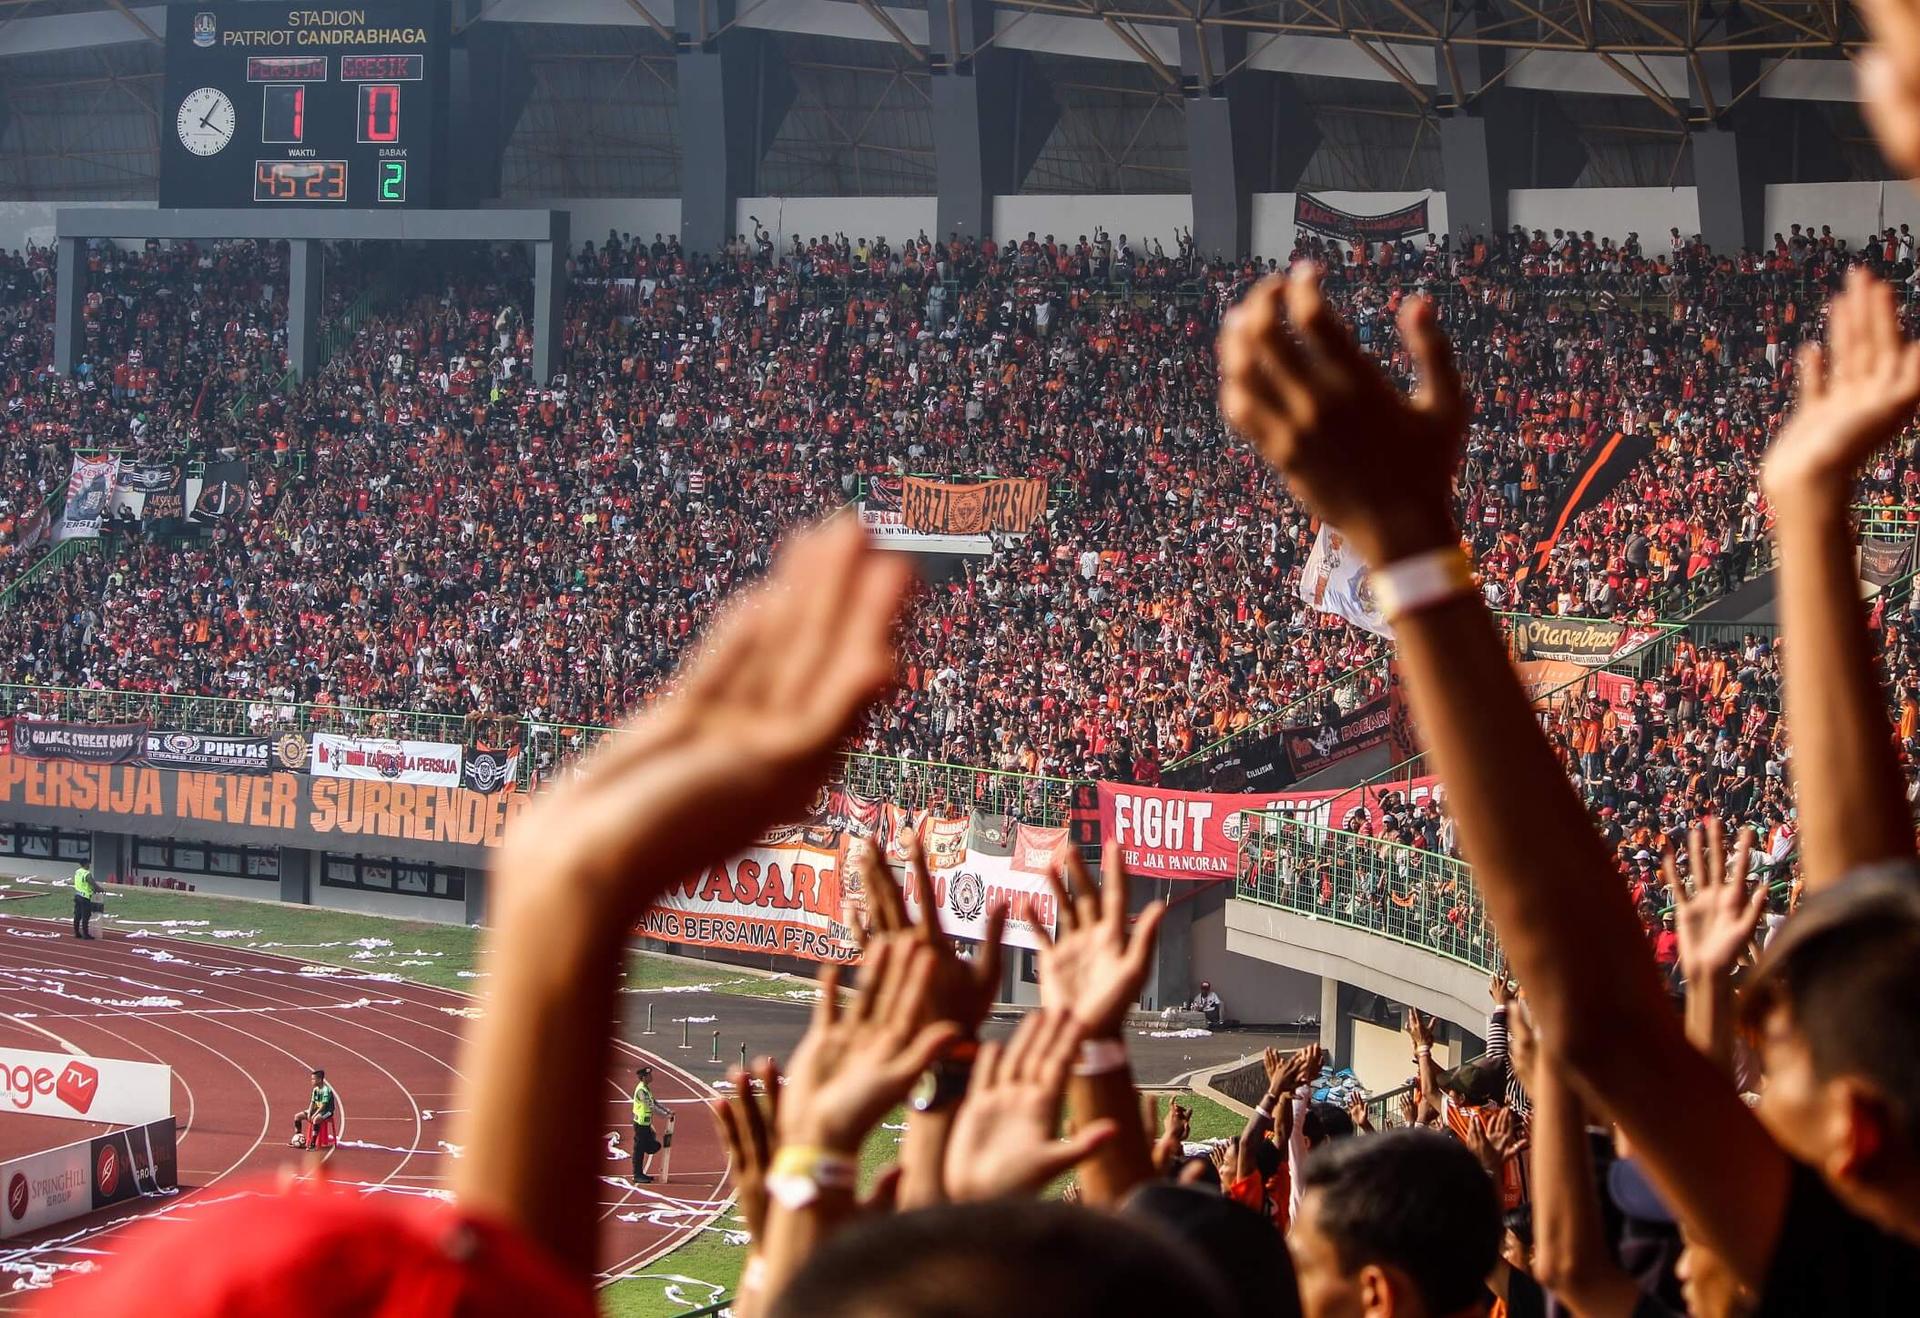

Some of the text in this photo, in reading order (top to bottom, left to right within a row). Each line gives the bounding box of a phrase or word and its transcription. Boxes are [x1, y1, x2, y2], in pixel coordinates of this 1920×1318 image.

[288, 10, 366, 26] STADION
[223, 29, 426, 46] PATRIOT CANDRABHAGA
[368, 87, 398, 141] 0
[379, 149, 407, 157] BABAK
[383, 164, 403, 198] 2
[905, 482, 950, 533] FORZA
[980, 481, 1046, 533] PERSIJA
[32, 731, 134, 749] ORANGE STREET BOYS
[205, 741, 268, 758] PINTAS
[417, 757, 457, 774] PERSIJA
[0, 755, 163, 816] PERSIJA
[176, 771, 298, 828] NEVER
[1114, 794, 1213, 851] FIGHT
[1143, 853, 1166, 869] JAK
[1168, 855, 1228, 871] PANCORAN
[684, 917, 778, 948] BERSAMA
[68, 1068, 93, 1089] TV
[135, 1165, 159, 1180] GROP
[32, 1168, 87, 1199] SPRINGHILL
[46, 1191, 72, 1207] GROUP
